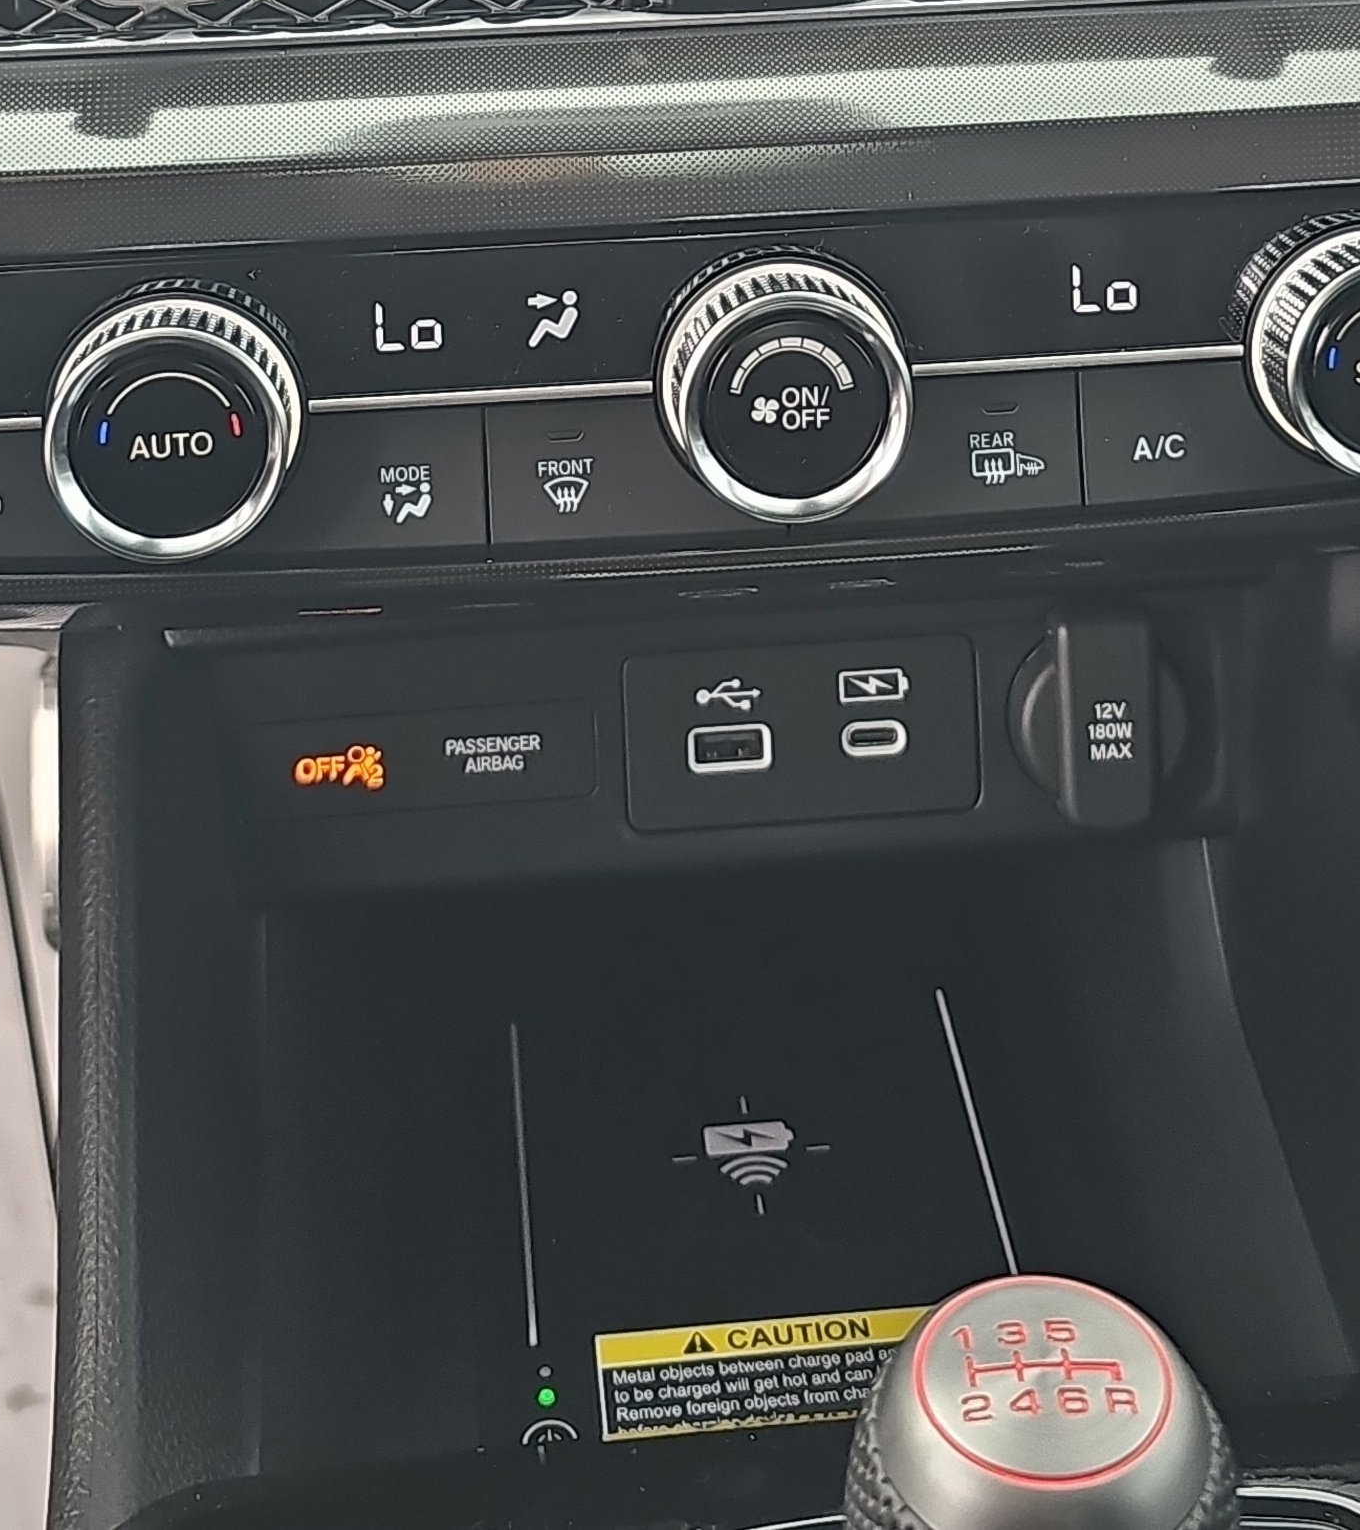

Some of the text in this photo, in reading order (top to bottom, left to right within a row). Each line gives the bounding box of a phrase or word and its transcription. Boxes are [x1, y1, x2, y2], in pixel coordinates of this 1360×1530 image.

[781, 385, 832, 410] ON/
[781, 408, 831, 431] OFF
[129, 431, 214, 462] AUTO
[969, 431, 1015, 449] REAR
[1132, 433, 1186, 462] A/C
[380, 465, 431, 483] MODE
[537, 458, 593, 477] FRONT
[1094, 701, 1127, 719] 12V
[1088, 722, 1133, 740] 180W
[445, 734, 541, 756] PASSENGER
[1090, 742, 1133, 761] MAX
[295, 756, 345, 785] OFF
[464, 754, 525, 774] AIRBAG
[727, 1317, 871, 1349] CAUTION
[950, 1318, 1077, 1350] 1 3 5
[612, 1367, 656, 1386] Metal
[660, 1362, 715, 1382] objects
[718, 1357, 785, 1376] between
[788, 1354, 841, 1370] charge
[845, 1346, 875, 1367] pad
[614, 1389, 630, 1404] to
[633, 1386, 654, 1402] be
[658, 1379, 721, 1400] charged
[725, 1377, 750, 1393] will
[753, 1373, 780, 1394] get
[782, 1371, 808, 1387] hot
[811, 1367, 841, 1385] and
[844, 1368, 873, 1383] can
[616, 1404, 682, 1422] Remove
[686, 1397, 740, 1416] foreign
[744, 1392, 800, 1412] objects
[803, 1388, 840, 1404] from
[960, 1385, 1138, 1423] 2 4 6 R
